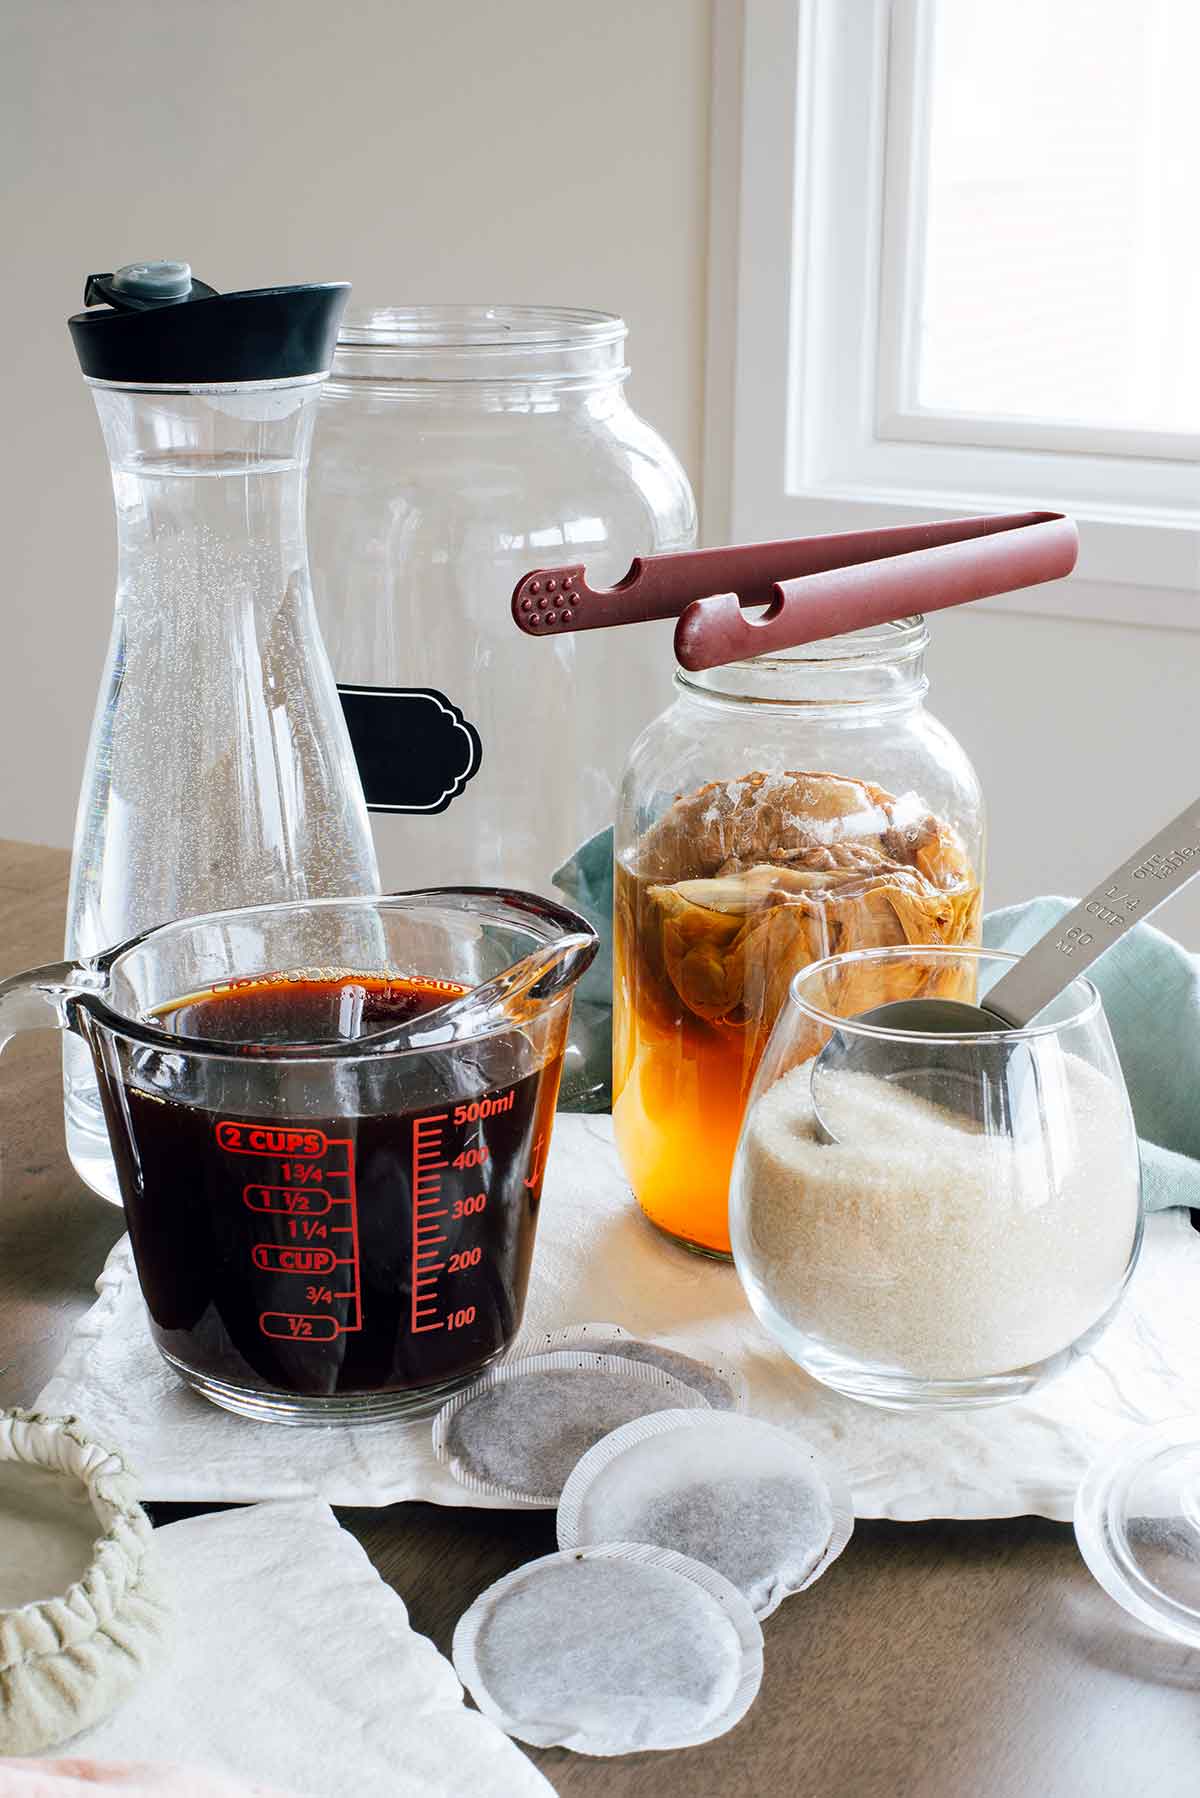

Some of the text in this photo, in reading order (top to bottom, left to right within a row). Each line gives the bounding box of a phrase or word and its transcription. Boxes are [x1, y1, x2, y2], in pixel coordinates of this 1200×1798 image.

[1105, 886, 1141, 912] 1/4
[1085, 900, 1126, 929] CUP
[1066, 927, 1094, 946] 60
[453, 1090, 515, 1125] 500ml
[224, 1127, 320, 1154] 2 CUPS
[452, 1145, 489, 1171] 400
[261, 1189, 271, 1207] 1
[451, 1193, 487, 1220] 300
[258, 1250, 330, 1270] 1 CUP
[447, 1247, 482, 1273] 200
[446, 1306, 477, 1331] 100
